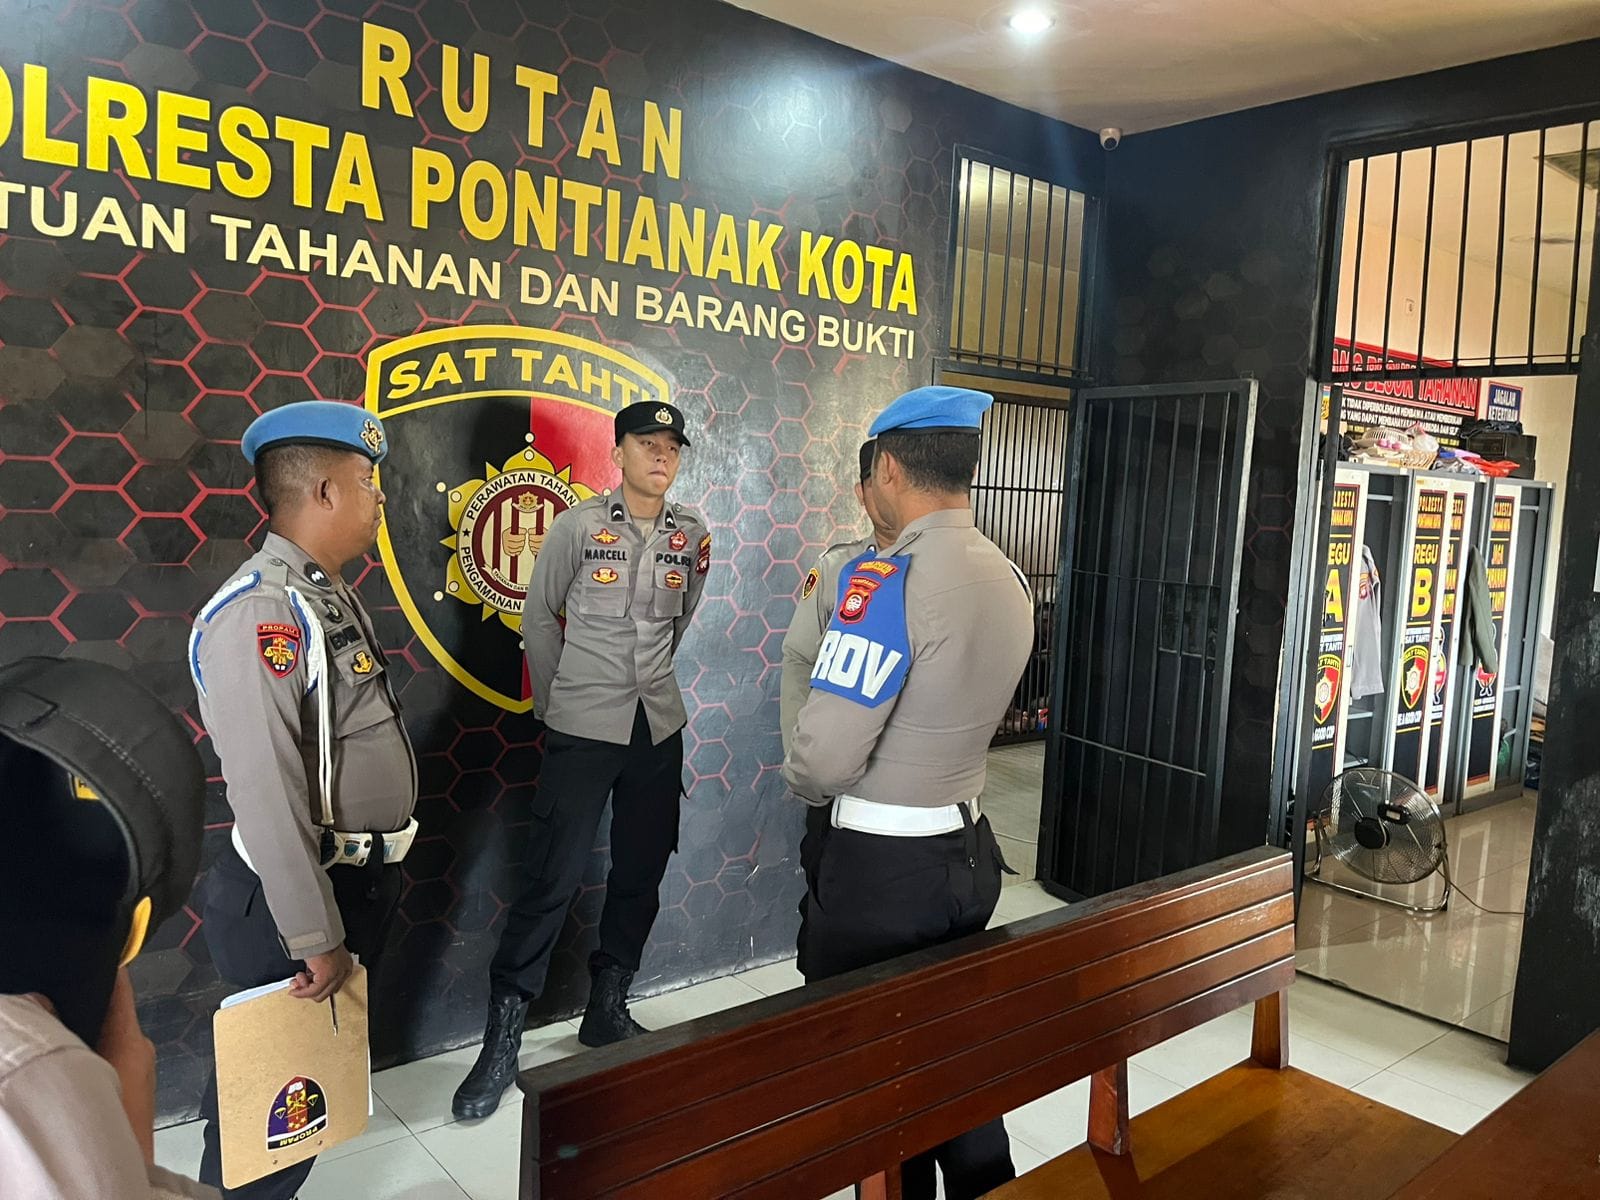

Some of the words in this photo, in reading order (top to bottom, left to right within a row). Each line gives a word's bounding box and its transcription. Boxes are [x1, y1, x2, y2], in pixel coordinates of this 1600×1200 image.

[0, 63, 383, 222] LRESTA
[411, 146, 783, 290] PONTIANAK
[798, 231, 918, 315] KOTA
[211, 214, 501, 300] TAHANAN
[520, 266, 619, 316] DAN
[636, 284, 805, 343] BARANG
[818, 315, 915, 359] BUKTI
[386, 348, 497, 400] SAT
[466, 473, 536, 521] PERAWATAN
[539, 473, 578, 509] TAHAN
[461, 547, 522, 611] PENGAMANAN
[584, 549, 628, 561] MARCELL
[1414, 544, 1438, 564] REGU
[1324, 569, 1343, 622] A
[1411, 568, 1432, 617] B
[262, 624, 295, 634] PROPAM
